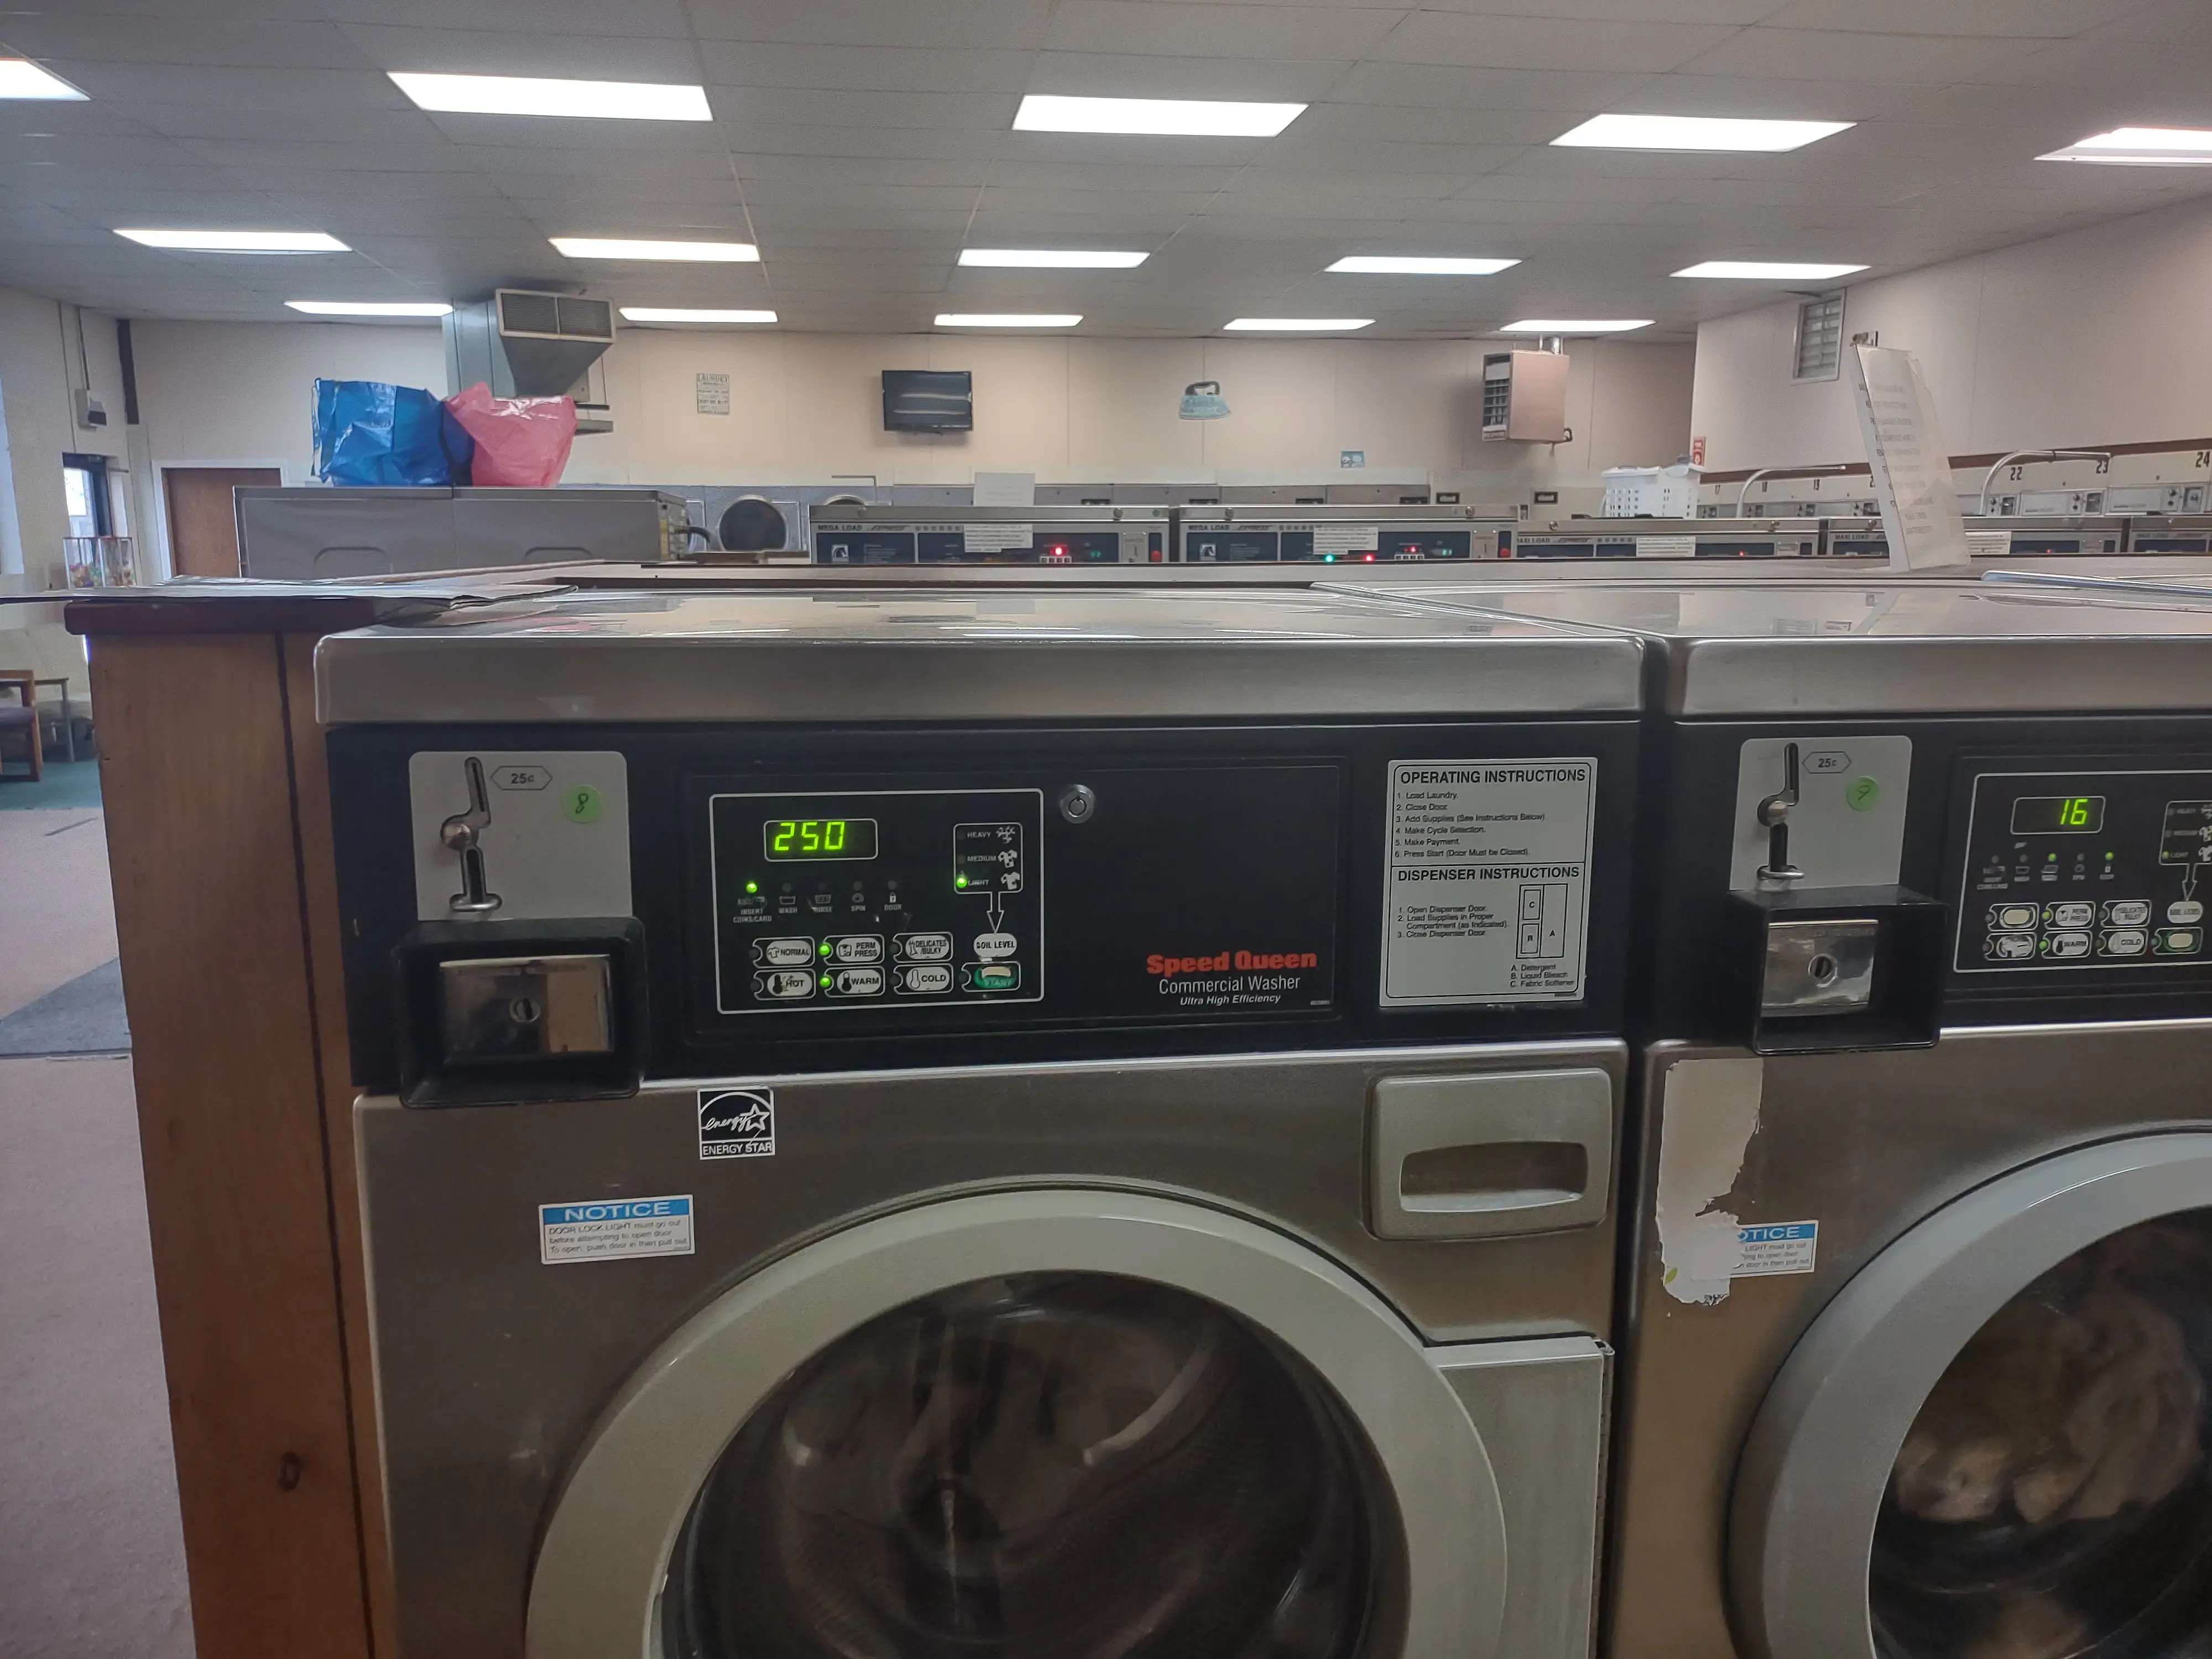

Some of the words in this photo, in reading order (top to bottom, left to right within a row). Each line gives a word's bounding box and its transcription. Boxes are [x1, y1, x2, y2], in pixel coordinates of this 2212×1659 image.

[2195, 451, 2210, 468] 24
[2010, 467, 2022, 481] 22
[1401, 771, 1480, 784] OPERATING
[1485, 769, 1585, 782] INSTRUCTIONS
[1427, 791, 1458, 800] Laundry.
[575, 792, 589, 815] 8
[1457, 814, 1474, 823] (See
[2059, 799, 2088, 825] 16
[774, 821, 846, 851] 250
[1427, 827, 1448, 835] Cycle
[1447, 849, 1467, 858] (Door
[1399, 869, 1475, 881] DISPENSER
[1480, 867, 1579, 879] INSTRUCTIONS
[1146, 951, 1229, 978] Speed
[1234, 951, 1317, 970] Queen
[786, 979, 805, 988] HOT
[1159, 977, 1243, 995] Commercial
[1248, 974, 1301, 991] Washer
[1180, 997, 1203, 1005] Ultra
[1207, 996, 1229, 1006] High
[1232, 994, 1281, 1004] Efficiency
[703, 1144, 743, 1156] ENERGY
[745, 1141, 773, 1154] STAR
[565, 1202, 671, 1221] NOTICE
[578, 1224, 603, 1233] LOCK
[606, 1223, 631, 1231] LIGHT
[1738, 1226, 1800, 1241] OTICE
[578, 1234, 619, 1242] attempting
